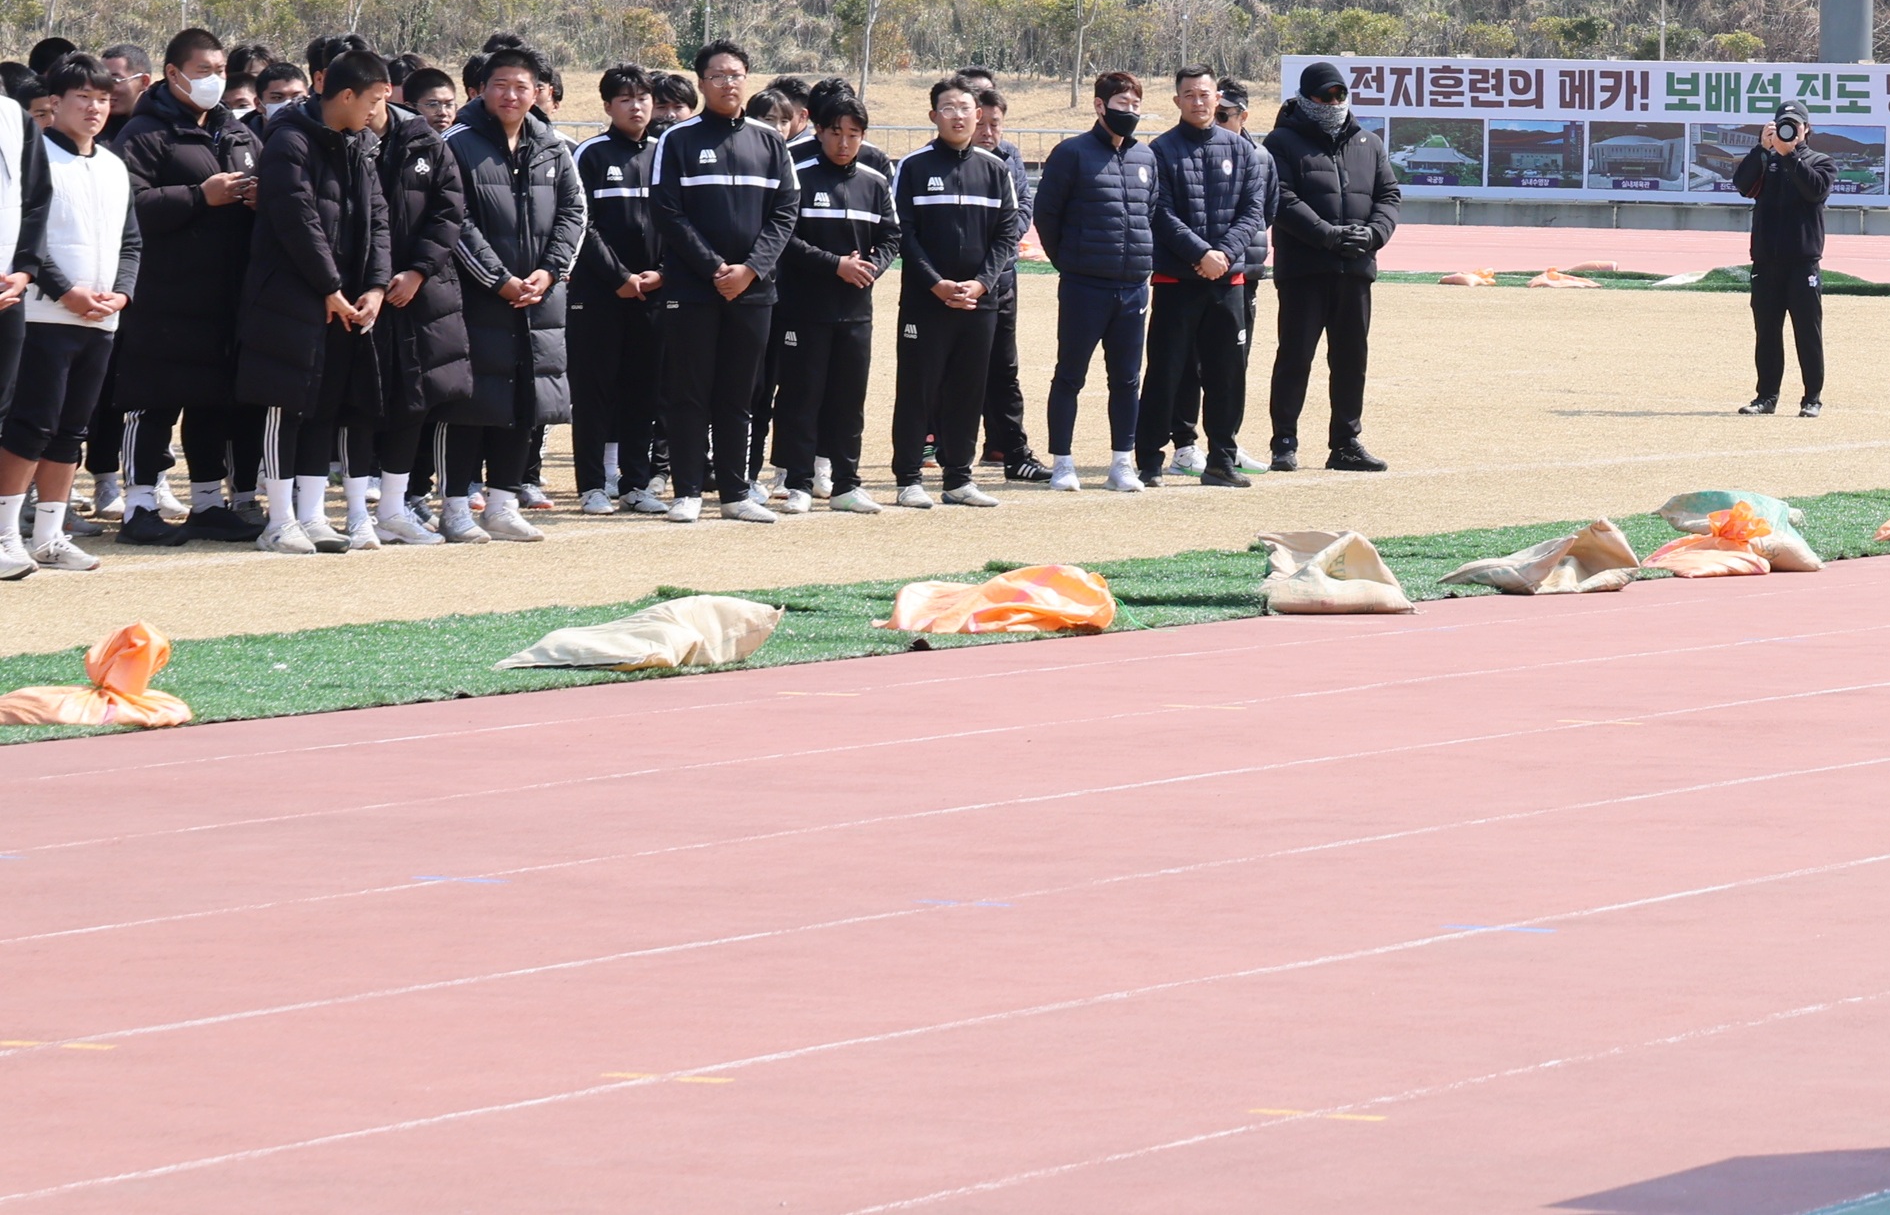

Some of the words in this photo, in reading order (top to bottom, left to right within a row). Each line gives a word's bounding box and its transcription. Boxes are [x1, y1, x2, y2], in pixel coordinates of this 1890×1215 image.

[1350, 64, 1544, 110] 전지훈련의
[1558, 69, 1650, 112] 메카!
[1664, 71, 1782, 114] 보배섬
[1796, 72, 1872, 114] 진도
[1426, 175, 1444, 184] 국궁장
[1520, 178, 1550, 187] 실내수영장
